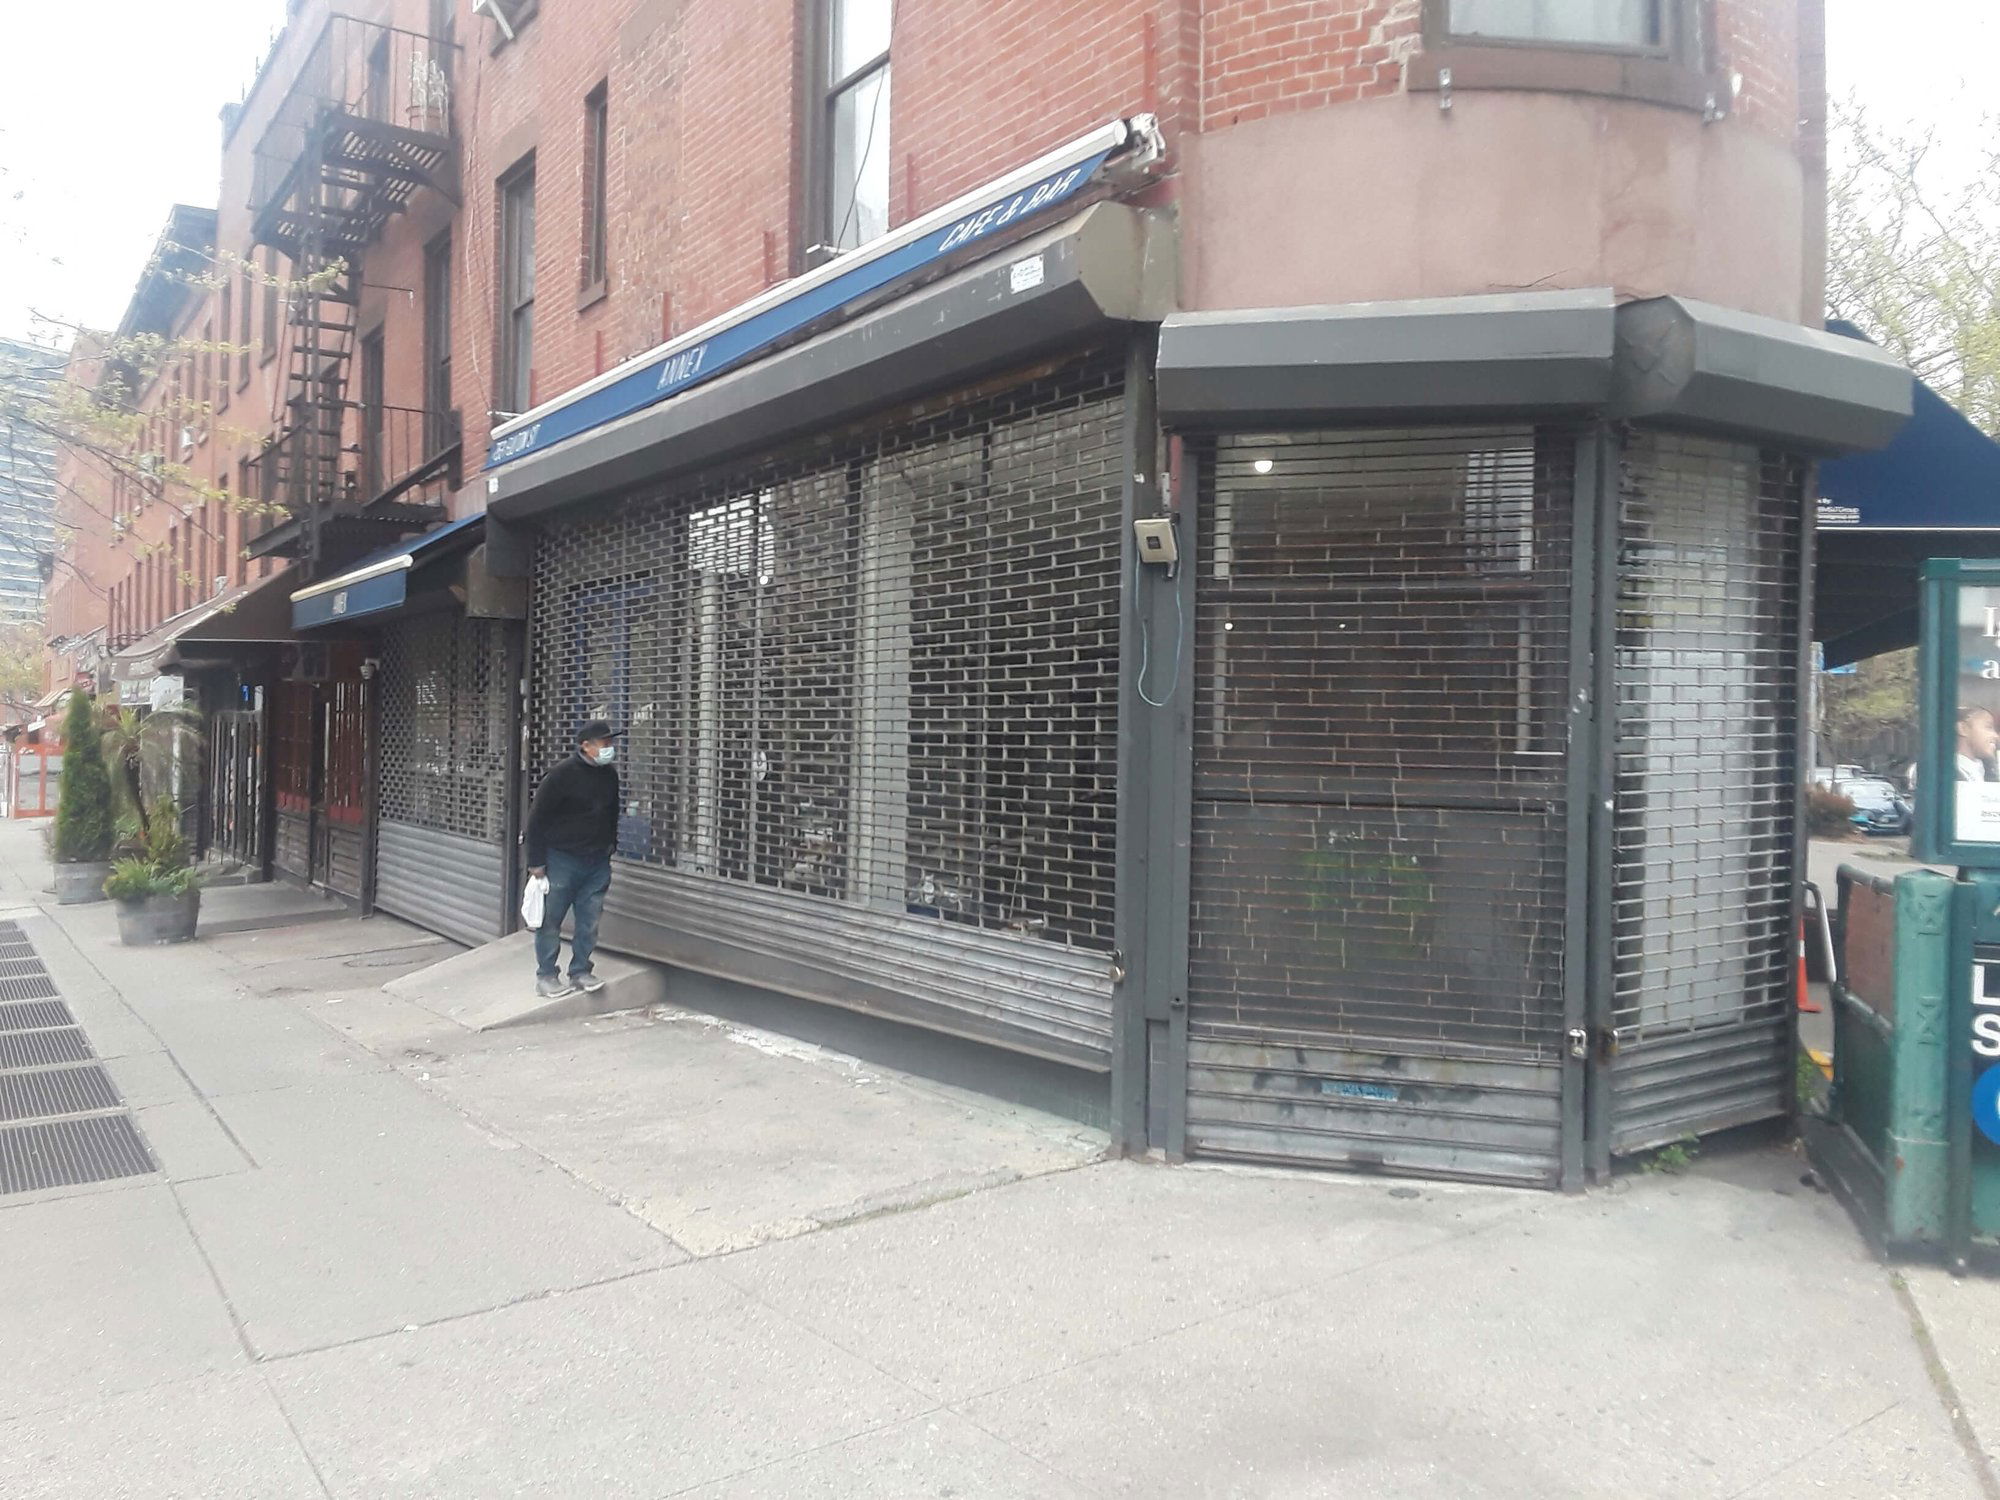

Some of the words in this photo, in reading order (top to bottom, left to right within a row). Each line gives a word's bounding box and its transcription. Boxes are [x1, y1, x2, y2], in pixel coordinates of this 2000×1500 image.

[938, 204, 1004, 251] CAFE
[995, 195, 1024, 226] &
[1019, 168, 1081, 215] BAR
[656, 344, 708, 390] ANNEX
